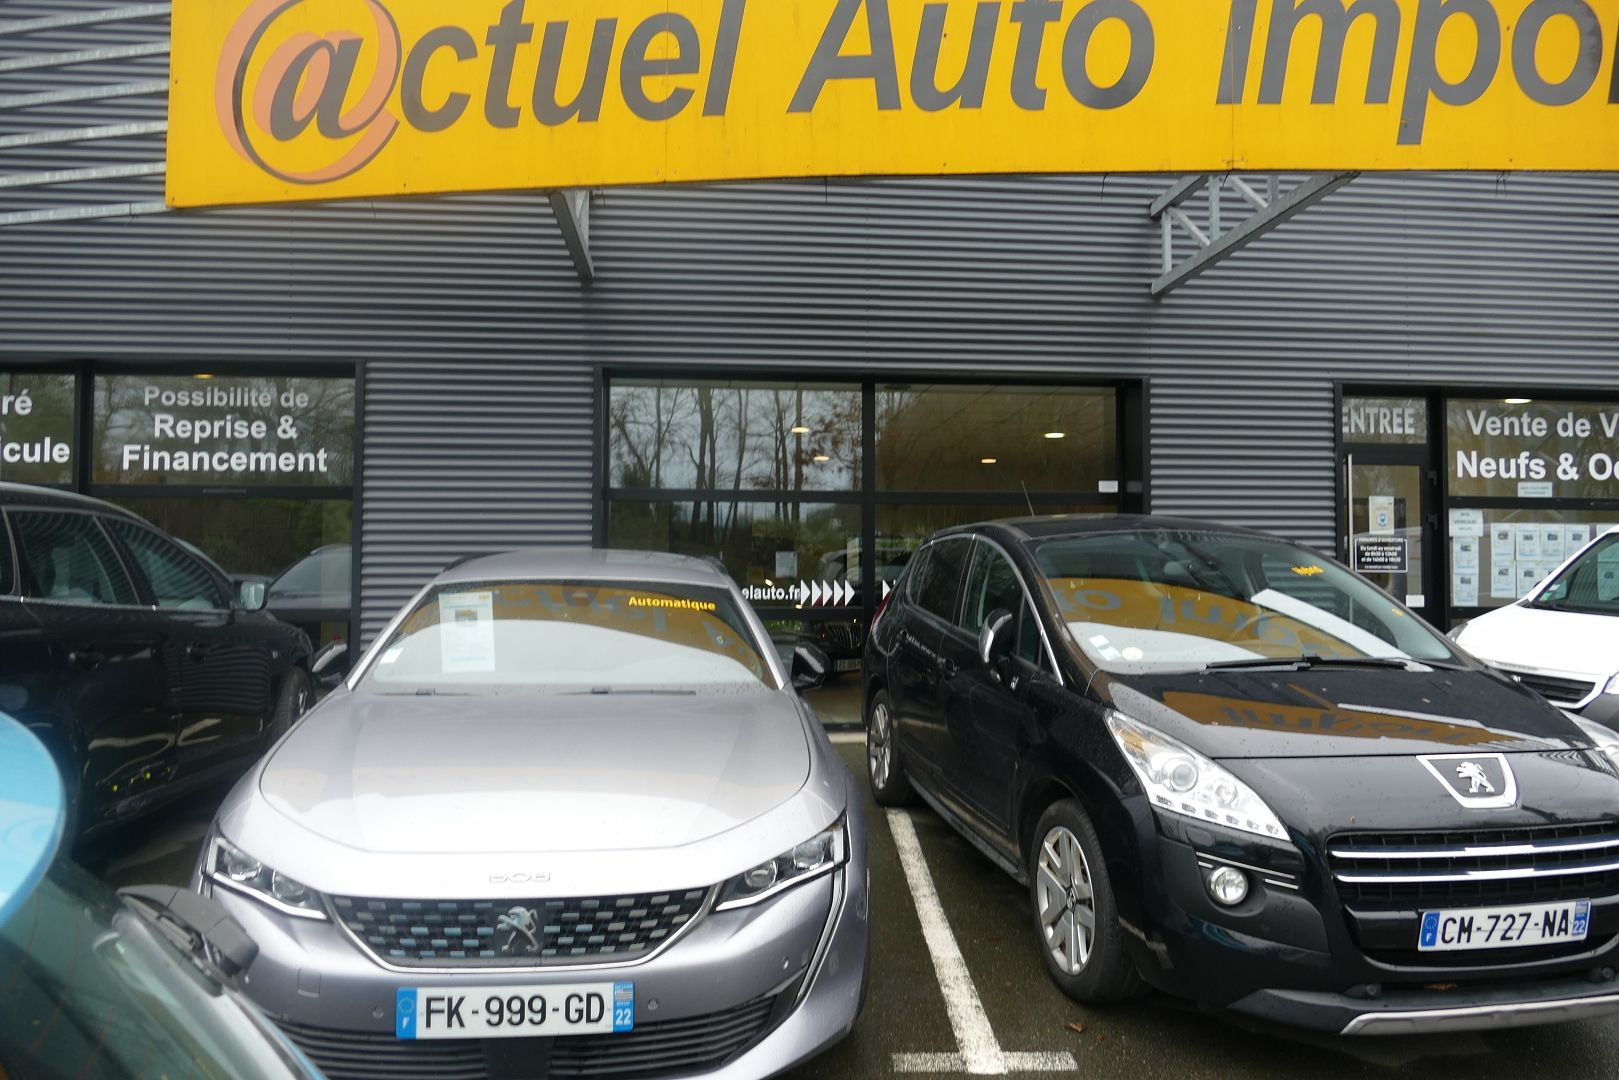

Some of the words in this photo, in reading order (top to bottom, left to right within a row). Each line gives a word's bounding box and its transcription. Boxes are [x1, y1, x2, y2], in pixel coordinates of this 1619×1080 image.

[786, 0, 1154, 112] Auto
[1216, 0, 1619, 145] Impo
[143, 386, 272, 406] Possibilité
[280, 387, 309, 408] de
[154, 414, 267, 443] Reprise
[277, 416, 297, 439] &
[1465, 410, 1548, 437] Vente
[1556, 412, 1591, 438] de
[0, 435, 70, 464] cule
[122, 444, 328, 473] Financement
[1456, 450, 1547, 479] Neufs
[1556, 452, 1579, 481] &
[628, 595, 716, 612] Automatique
[1440, 908, 1569, 944] CM-727-NA
[1572, 919, 1585, 933] 22
[425, 992, 606, 1029] FK-999-GD
[615, 1009, 632, 1026] 22
